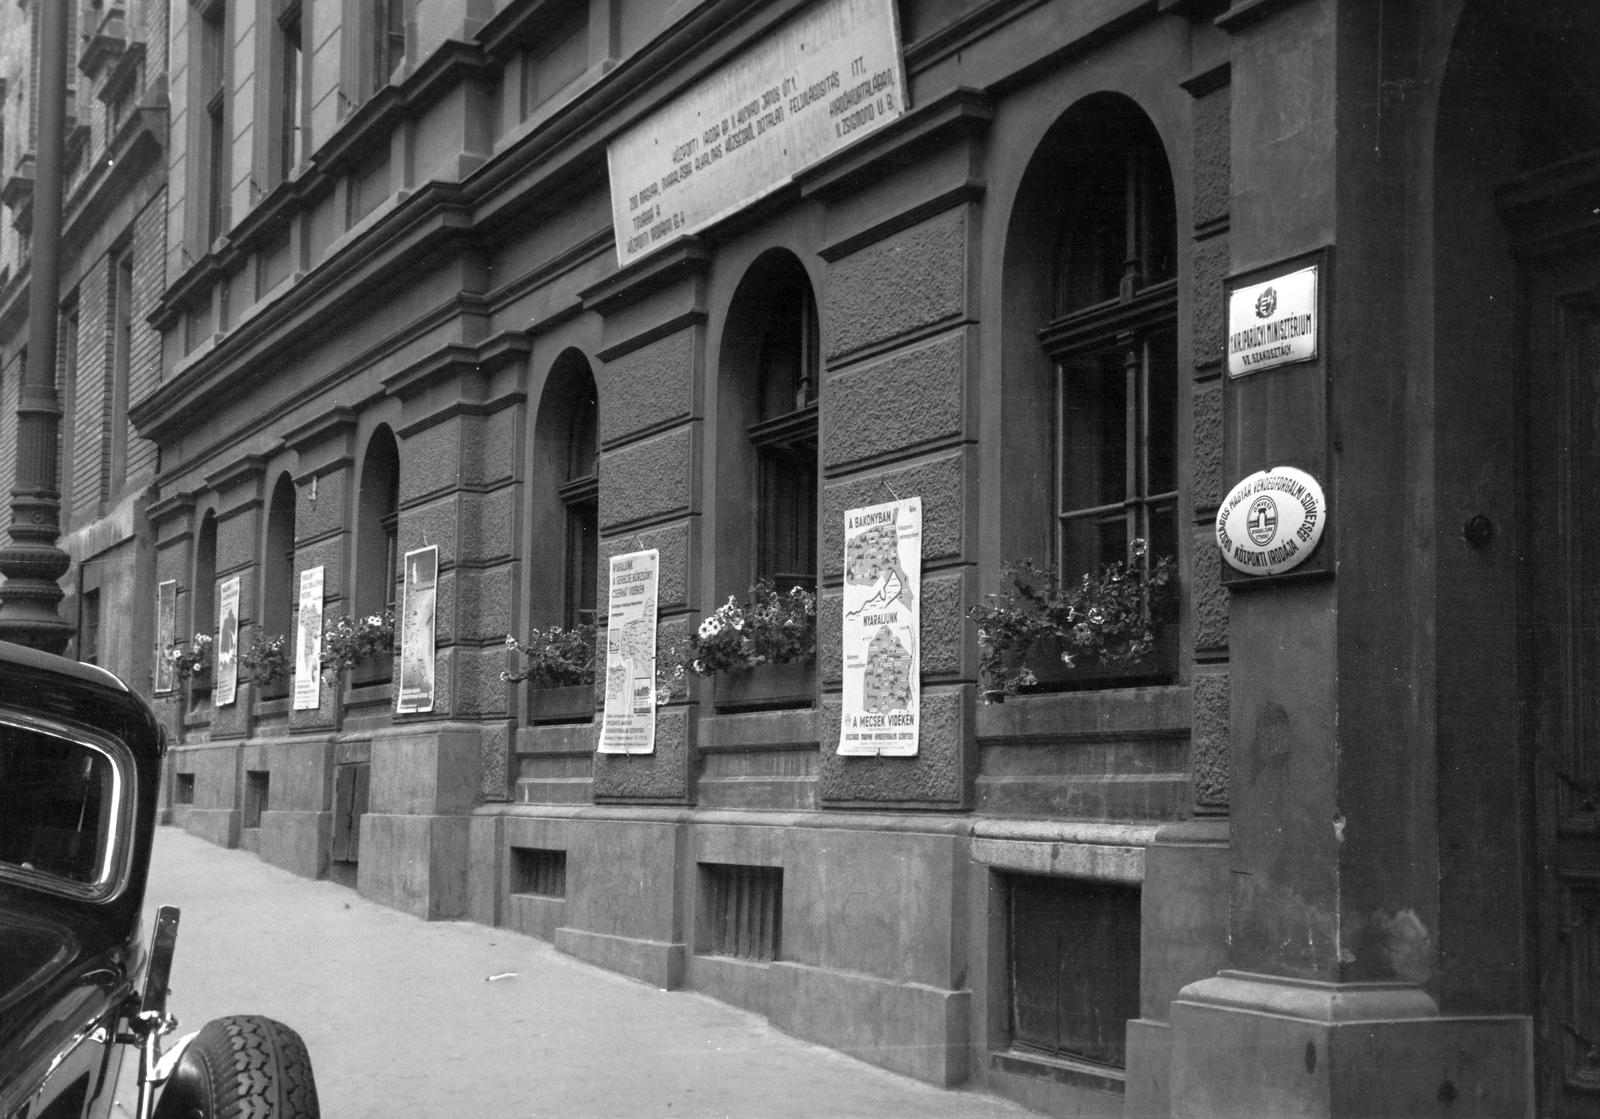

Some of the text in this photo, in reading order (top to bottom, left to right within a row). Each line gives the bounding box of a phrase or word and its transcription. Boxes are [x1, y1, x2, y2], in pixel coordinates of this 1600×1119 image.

[1229, 484, 1251, 510] MAGYAR
[848, 511, 891, 530] A BAKONYBAN
[1234, 539, 1299, 566] KÖZPONTI IRODÁJA
[863, 611, 897, 626] NYARALJUNK
[853, 710, 914, 727] A MECSEK VIDÉKÉN
